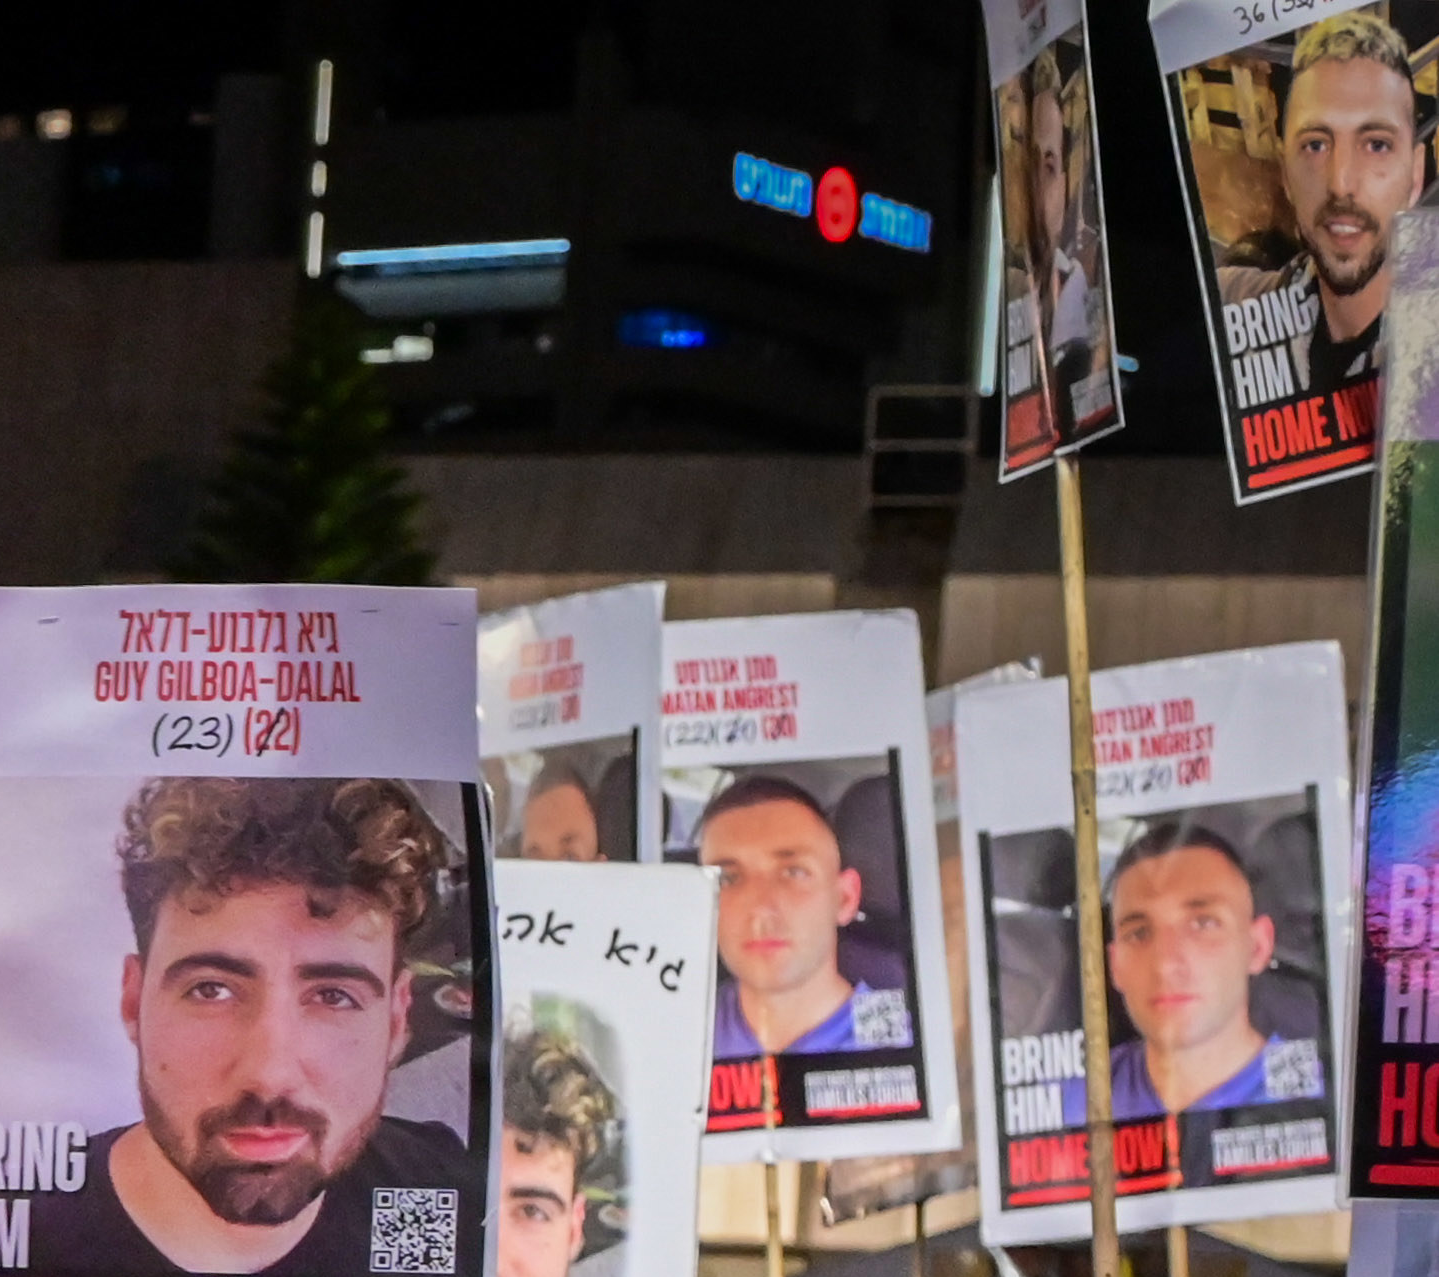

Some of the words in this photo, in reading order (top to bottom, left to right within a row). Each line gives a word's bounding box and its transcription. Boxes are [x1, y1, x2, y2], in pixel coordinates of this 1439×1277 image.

[1222, 284, 1319, 356] BRING
[1232, 353, 1295, 408] HIM
[1242, 398, 1329, 466] HOME
[119, 608, 288, 654] גלבוע-דלאל
[295, 611, 340, 654] גיא
[95, 660, 150, 702] GUY
[157, 662, 360, 703] GILBOA-DALAL
[150, 711, 233, 756] (23)
[1003, 1080, 1063, 1131] HIM
